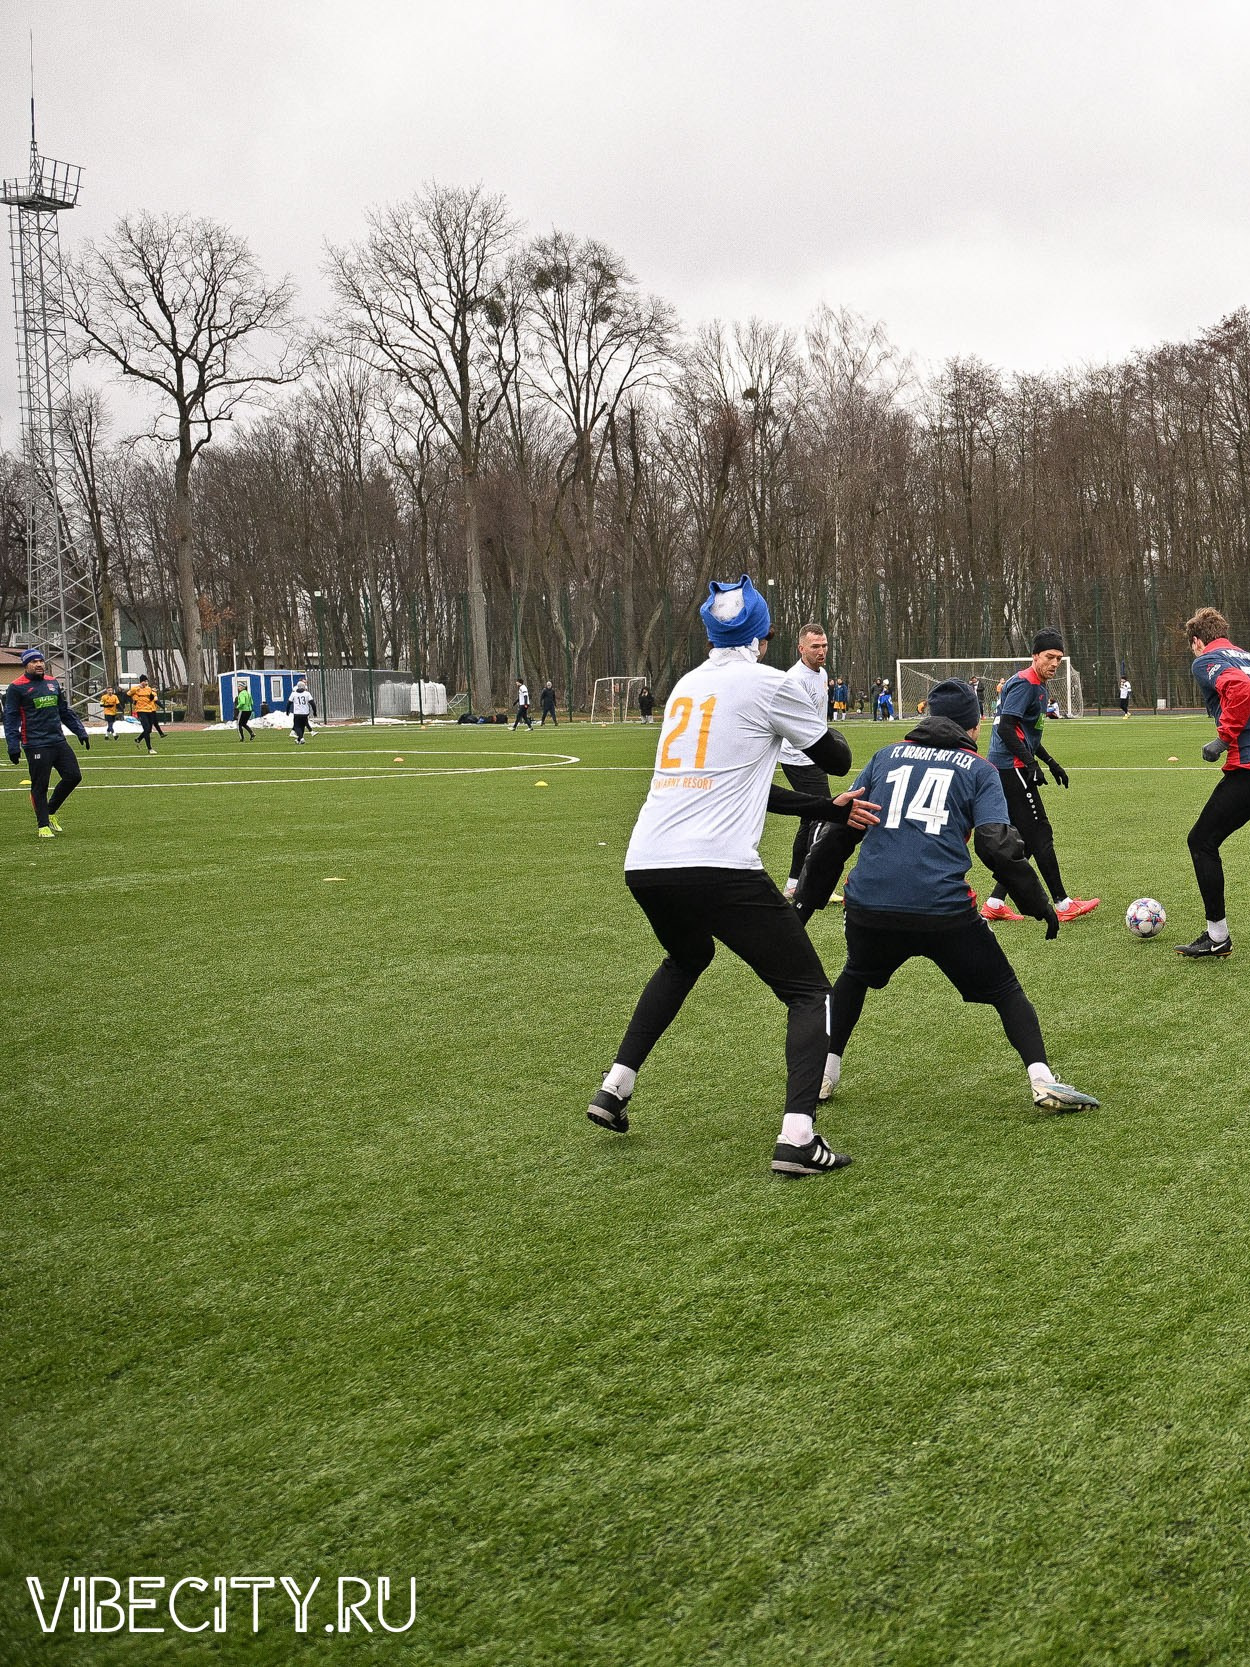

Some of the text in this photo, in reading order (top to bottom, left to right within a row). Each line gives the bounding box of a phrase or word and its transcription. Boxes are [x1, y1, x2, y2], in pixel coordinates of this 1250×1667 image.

[297, 696, 306, 706] 13
[660, 695, 717, 769] 21
[890, 745, 976, 771] FC ARARAT-ART FLEX
[682, 775, 715, 791] RESORT
[884, 764, 955, 836] 14
